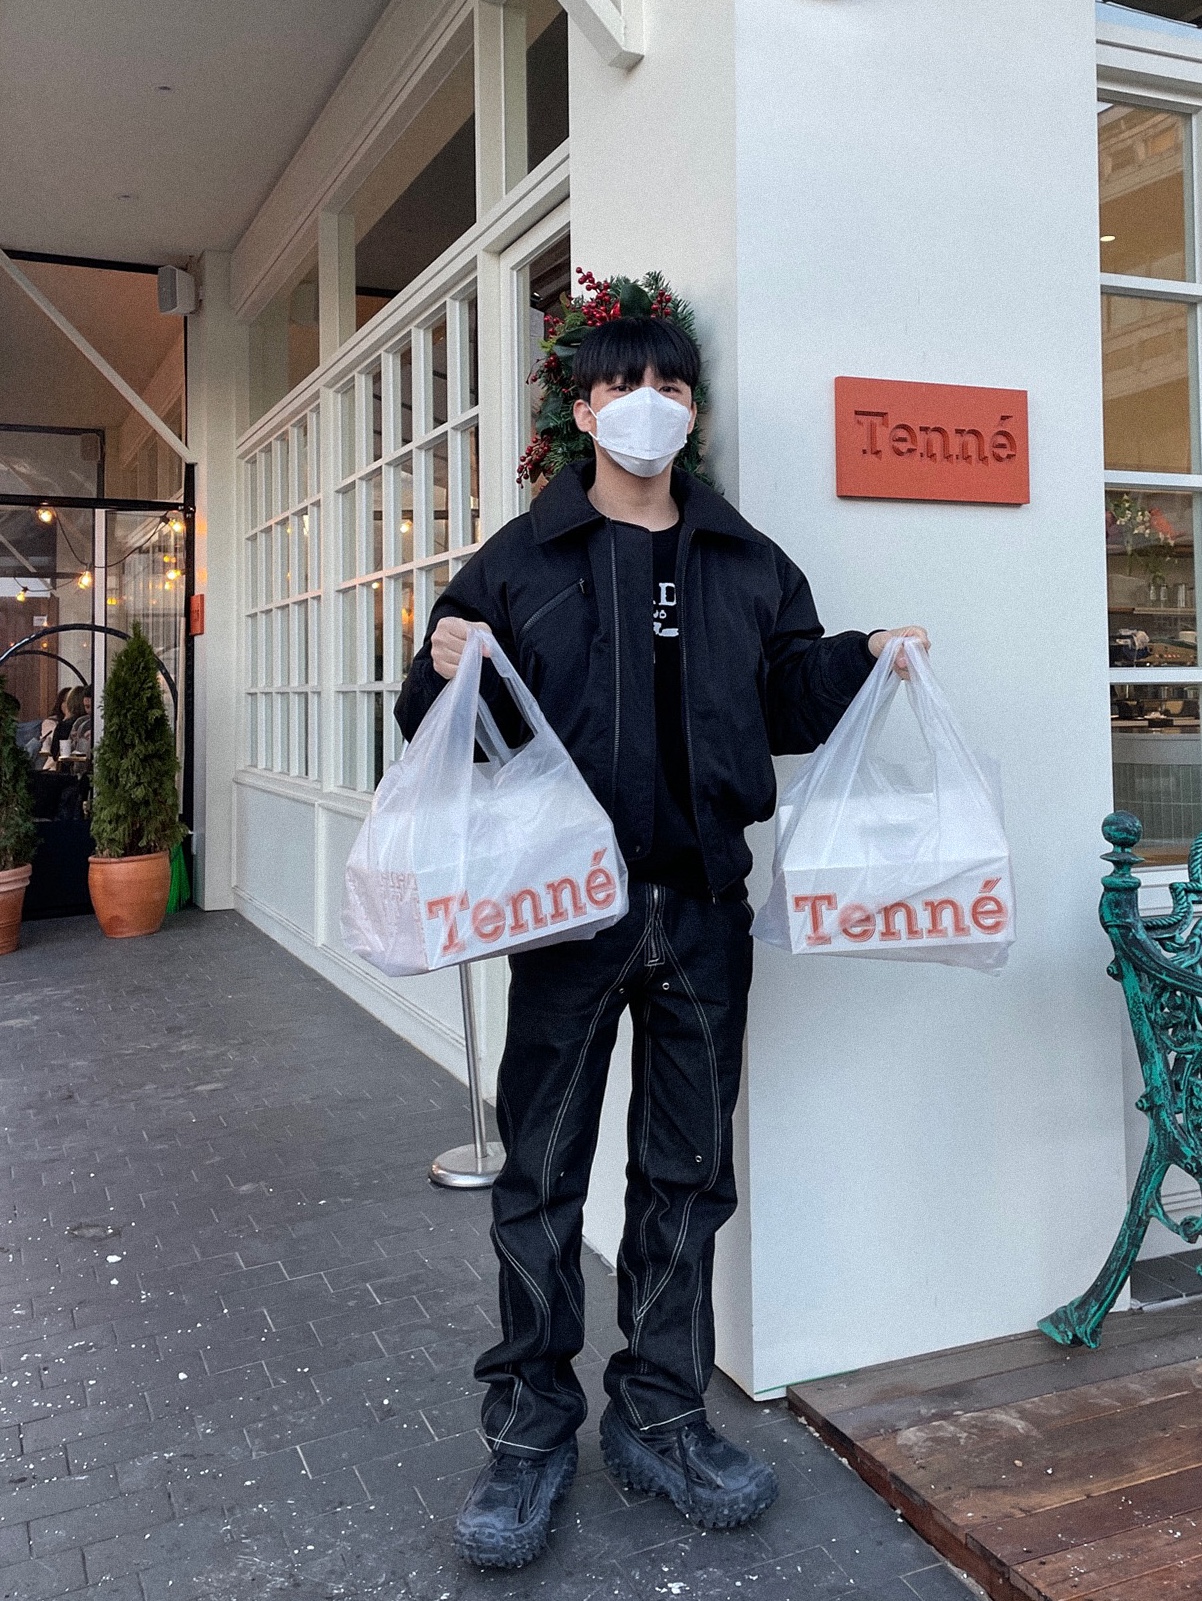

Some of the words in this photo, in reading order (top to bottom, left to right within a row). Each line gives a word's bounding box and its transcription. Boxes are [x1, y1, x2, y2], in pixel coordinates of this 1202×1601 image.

[854, 409, 1017, 466] Tenné
[426, 847, 617, 957] Tenné
[792, 877, 1008, 945] Tenné
